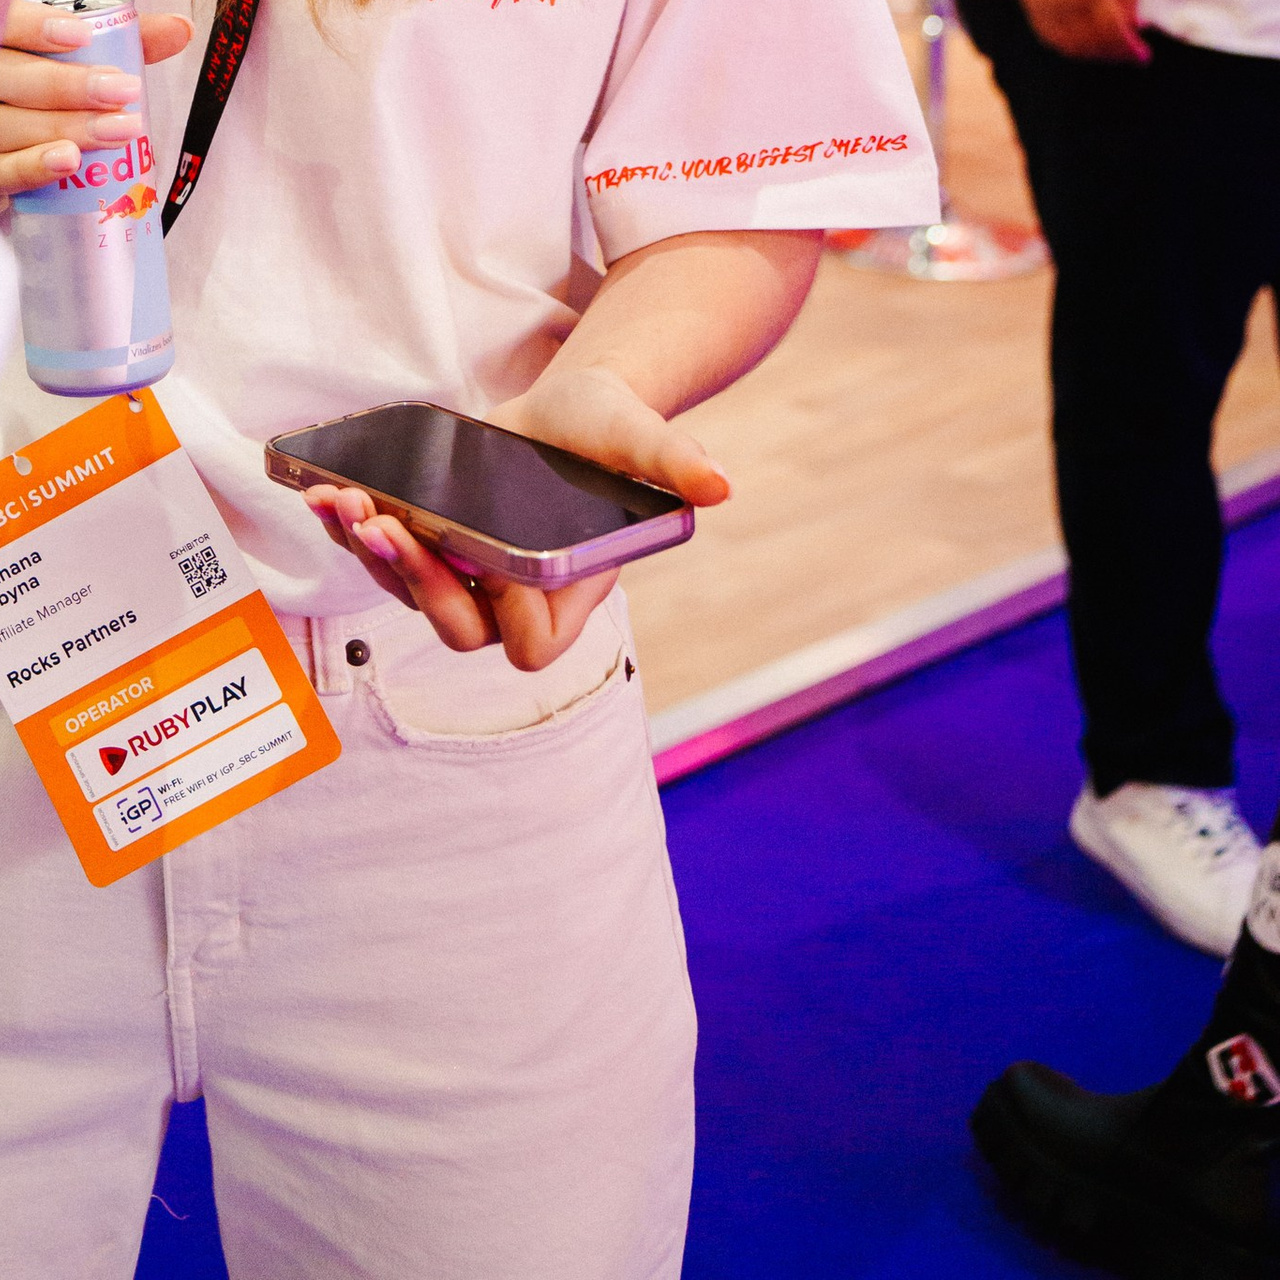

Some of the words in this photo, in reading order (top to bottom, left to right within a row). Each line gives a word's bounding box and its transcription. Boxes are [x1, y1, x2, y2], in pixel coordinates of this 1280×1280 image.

[682, 156, 733, 182] YOUR
[736, 141, 824, 173] BIGGEST
[824, 134, 908, 159] CHECKS
[98, 222, 154, 249] ZER
[169, 533, 211, 561] EXHIBITOR
[36, 583, 93, 622] Manager
[6, 651, 61, 689] Rocks
[61, 609, 138, 659] Partners
[65, 676, 156, 734] OPERATOR
[127, 676, 249, 757] RUBYPLAY
[157, 777, 184, 796] WI-FI:
[163, 790, 187, 807] FREE
[186, 779, 206, 795] WIFI
[206, 771, 219, 784] BY
[257, 730, 293, 756] SUMMIT
